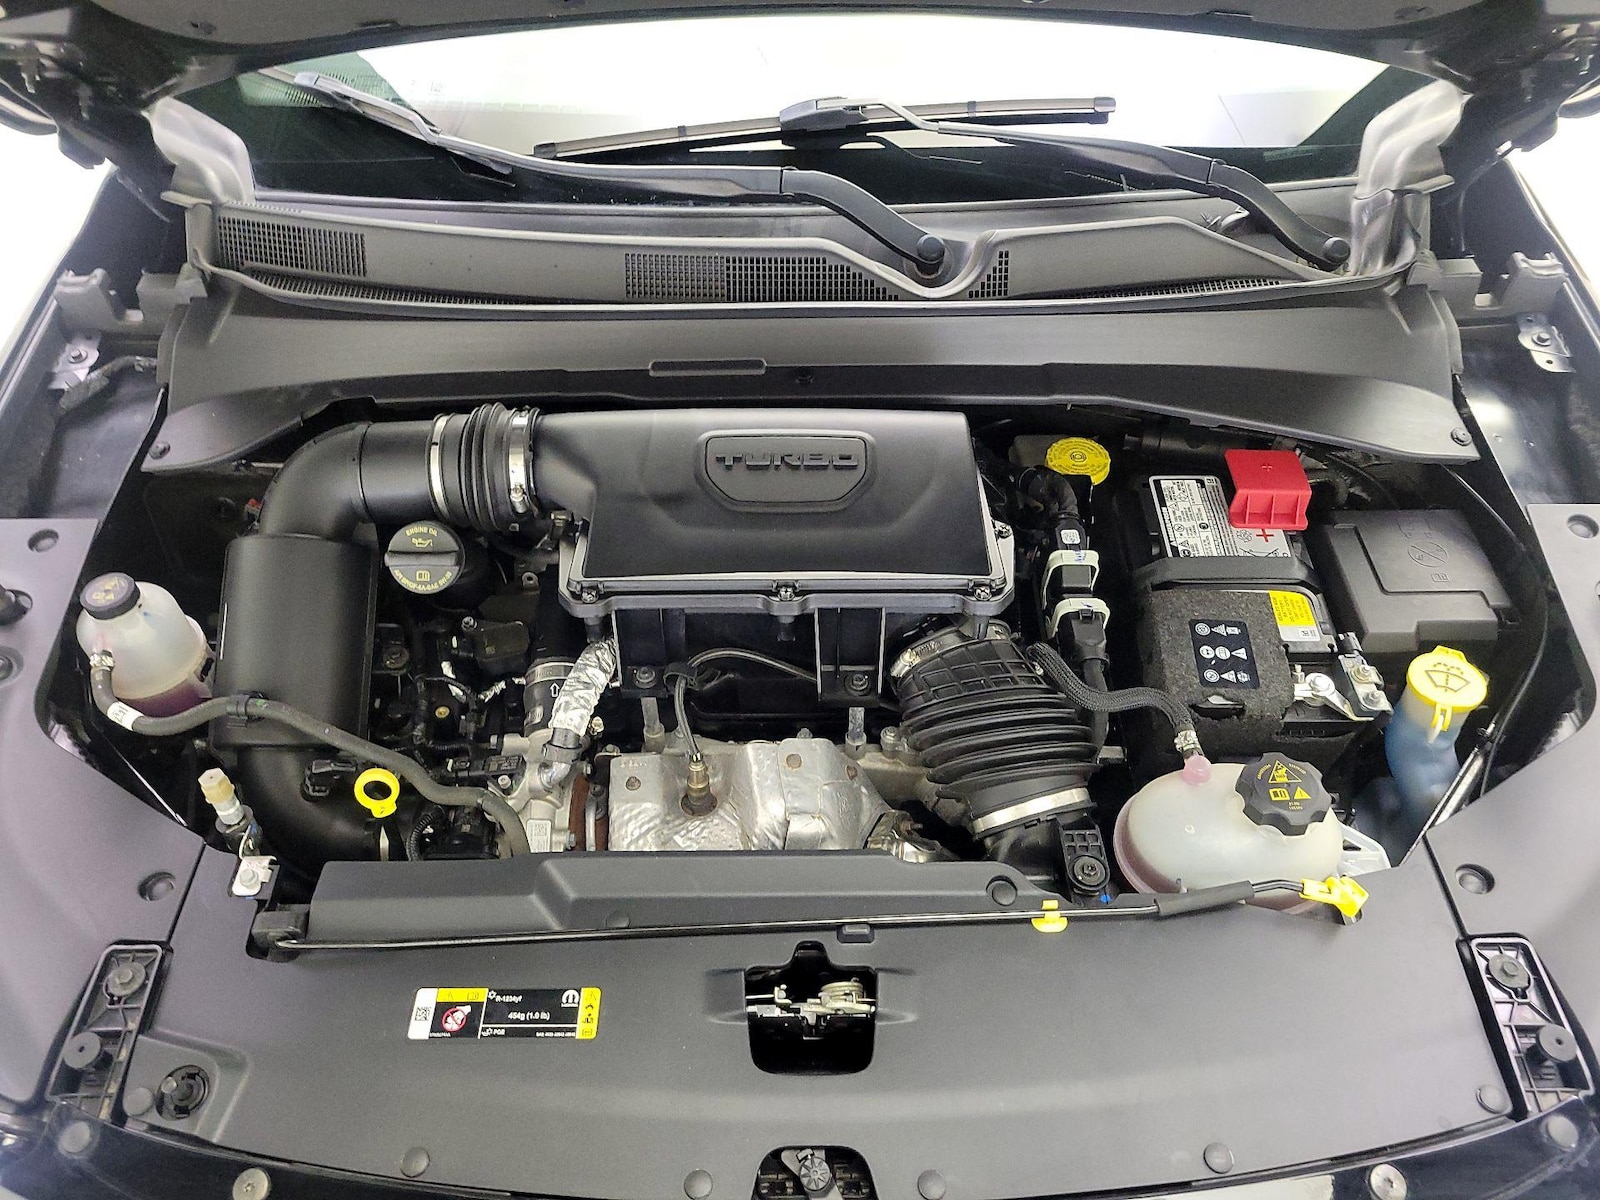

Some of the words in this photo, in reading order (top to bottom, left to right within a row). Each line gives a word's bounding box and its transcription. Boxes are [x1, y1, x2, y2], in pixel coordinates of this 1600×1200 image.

[715, 453, 859, 470] TURBO
[405, 525, 428, 536] ENGINE
[428, 527, 437, 536] OIL
[508, 1012, 525, 1021] 454g
[526, 1012, 540, 1021] (1.0
[541, 1012, 551, 1021] lb)
